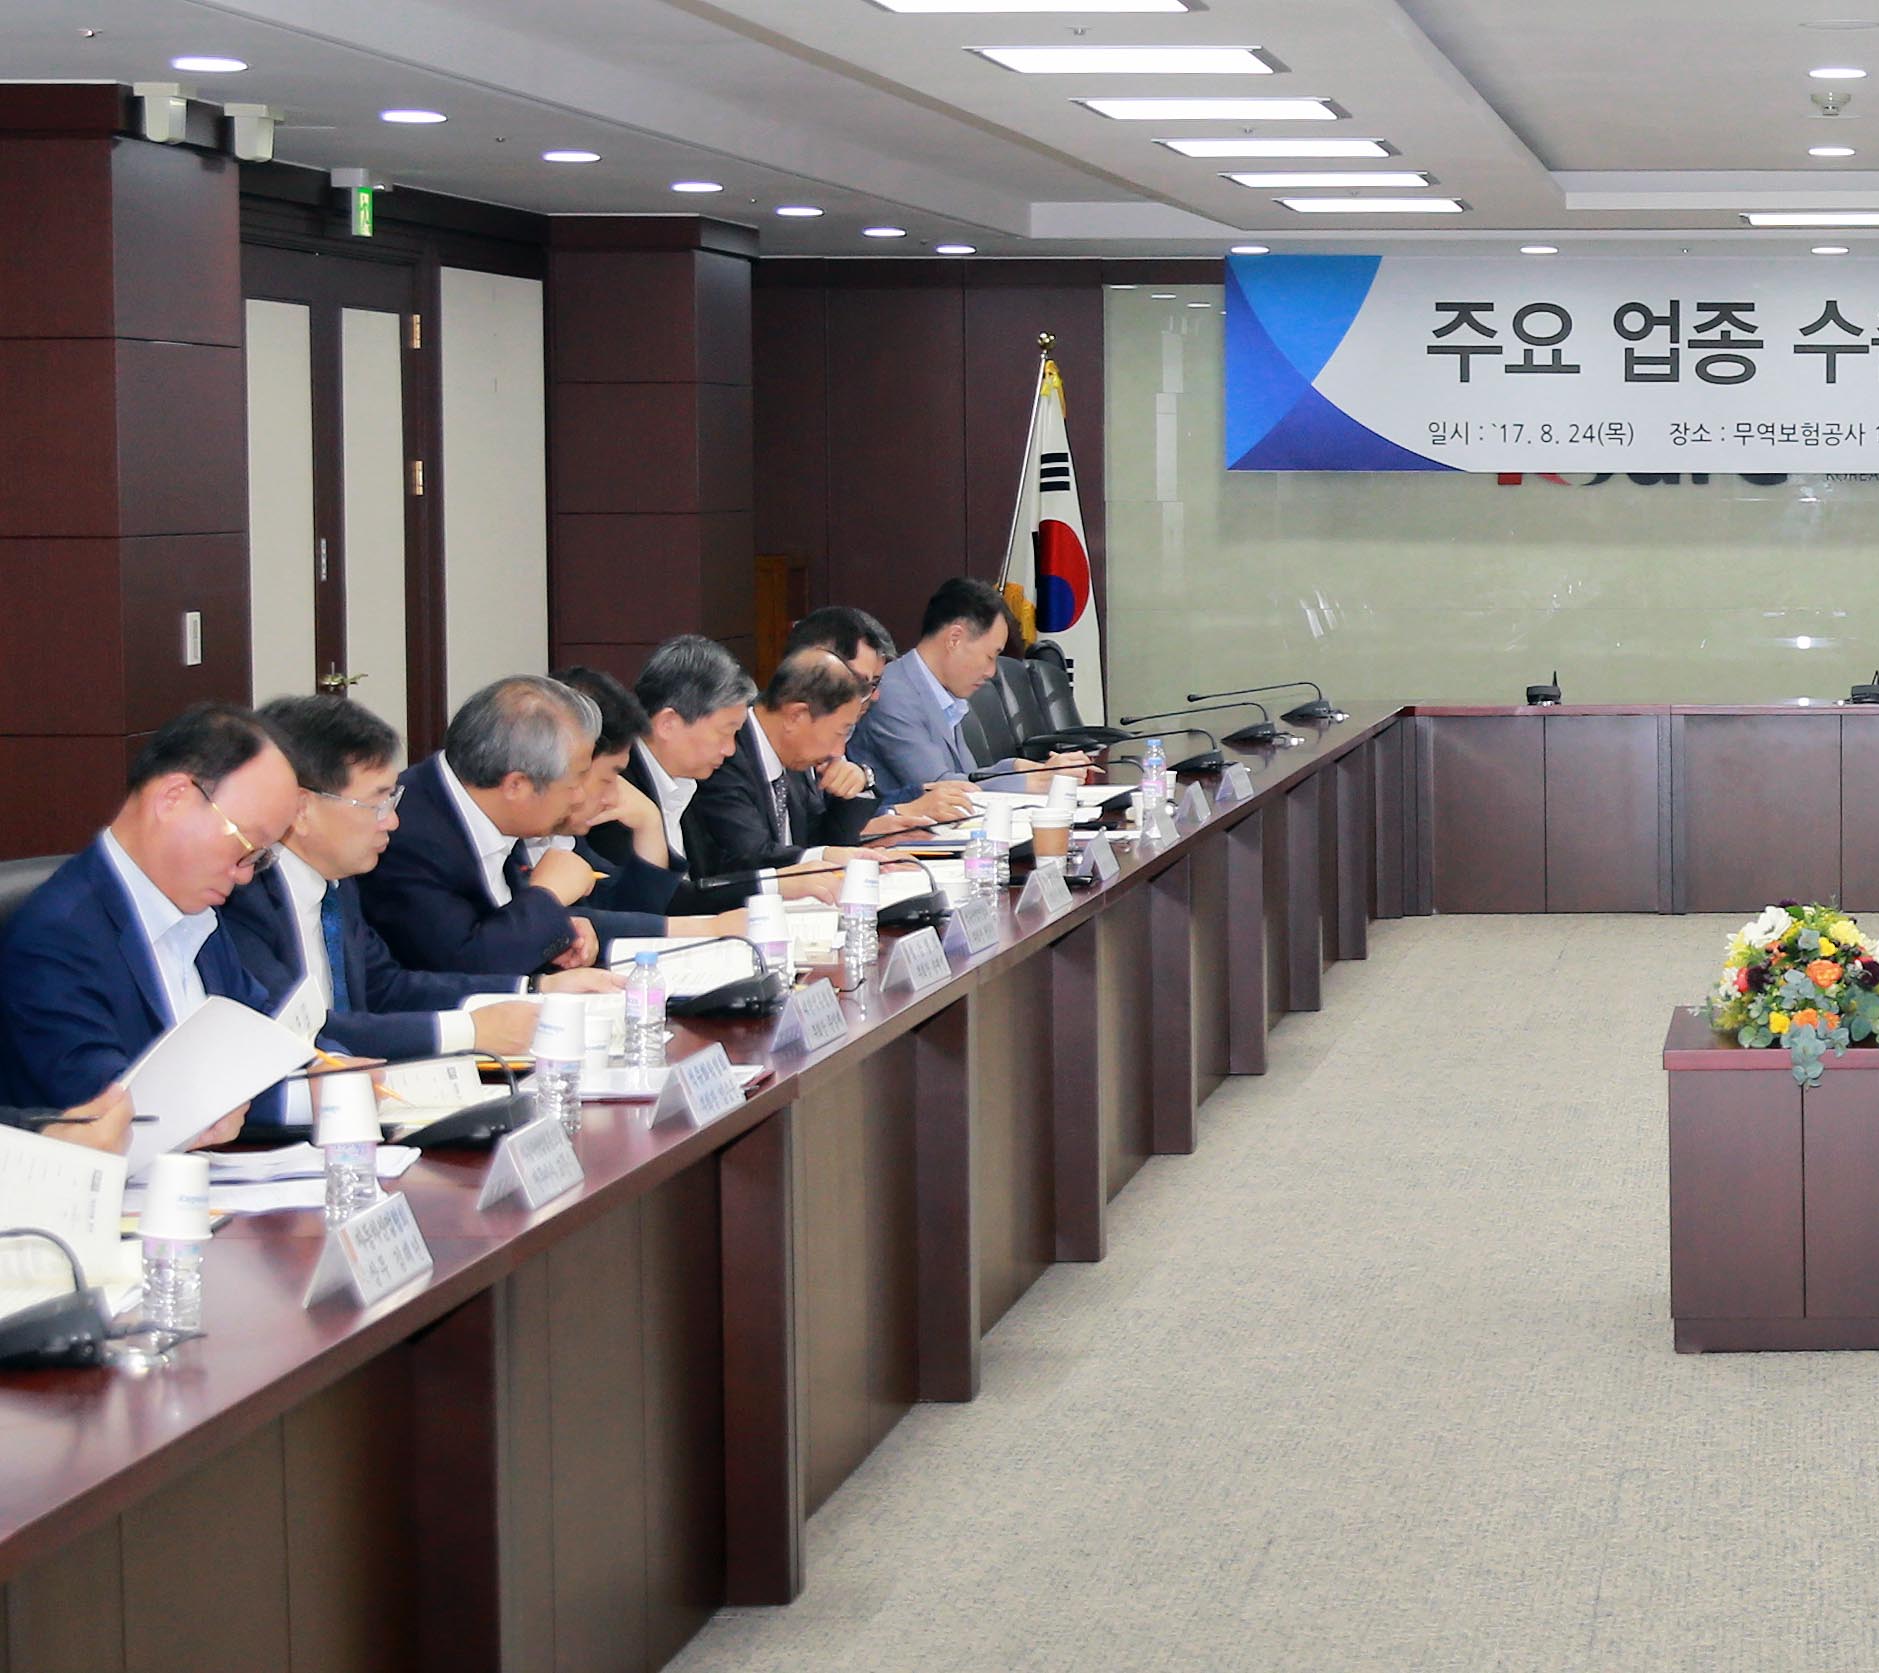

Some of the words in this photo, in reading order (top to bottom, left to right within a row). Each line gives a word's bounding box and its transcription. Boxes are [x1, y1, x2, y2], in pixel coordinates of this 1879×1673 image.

[1426, 301, 1581, 383] 주요
[1613, 299, 1764, 386] 업종
[1427, 421, 1471, 447] 일시
[1540, 423, 1560, 445] 8.
[1568, 421, 1635, 448] 24(목)
[1669, 421, 1713, 447] 장소
[1733, 422, 1866, 447] 무역보험공사
